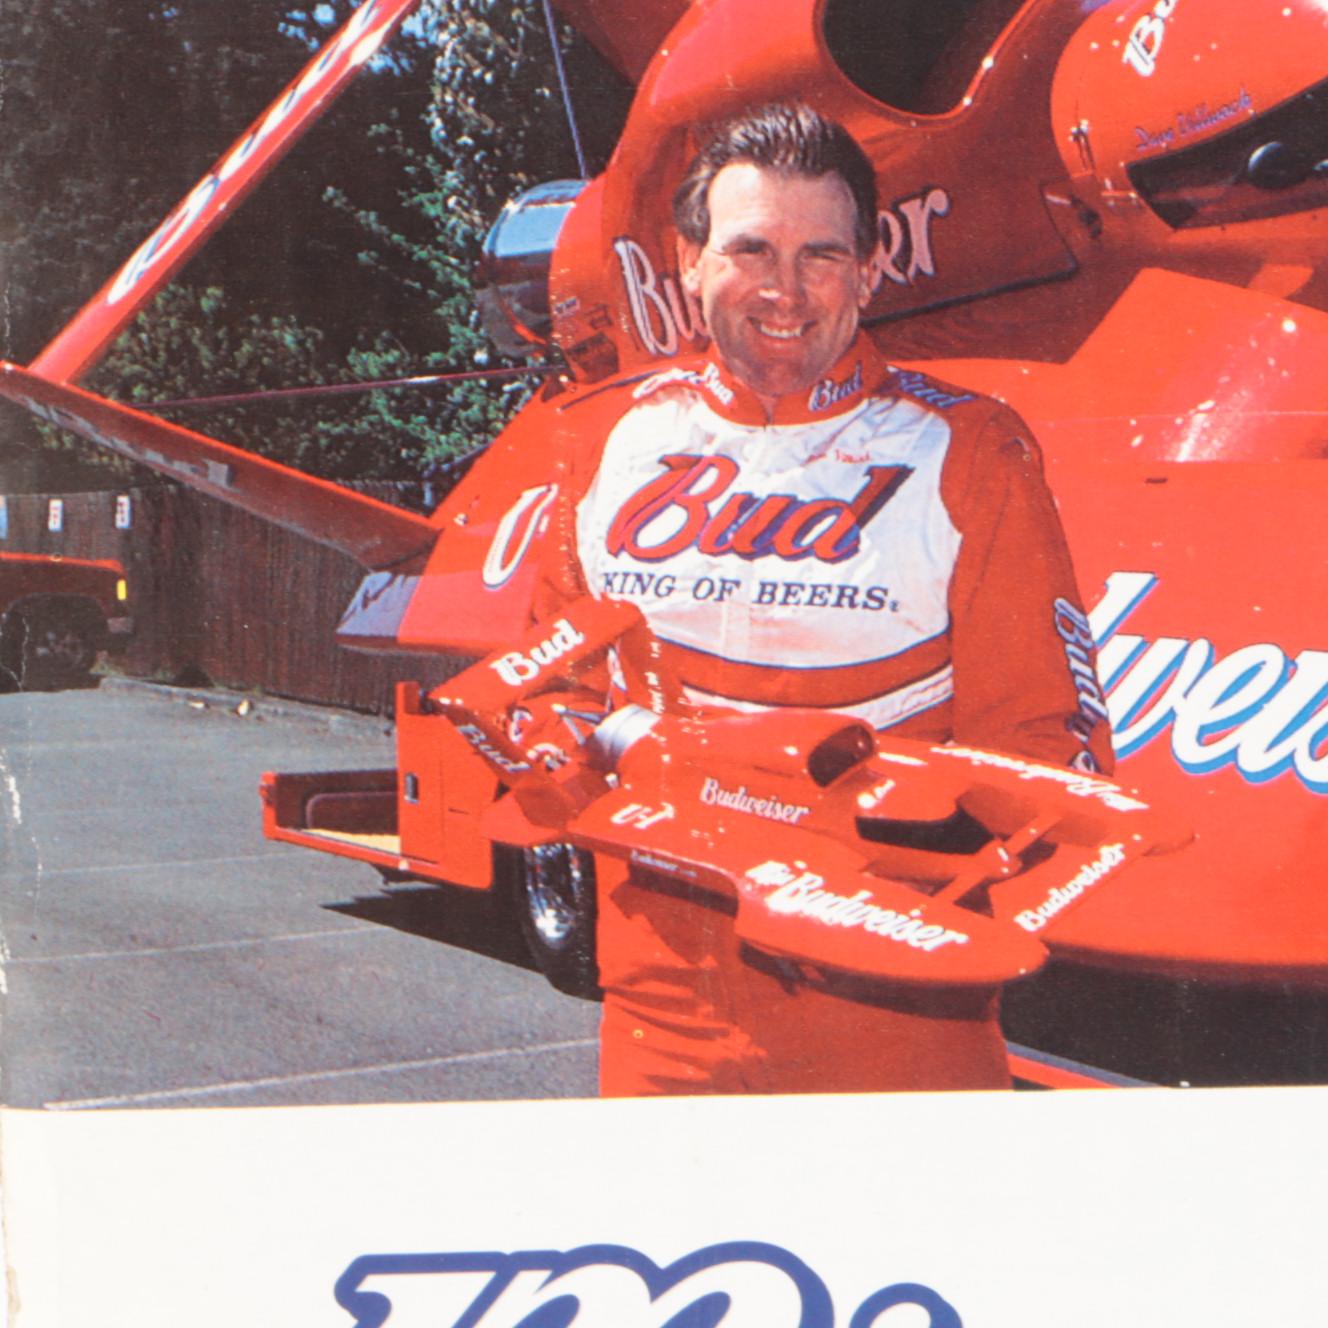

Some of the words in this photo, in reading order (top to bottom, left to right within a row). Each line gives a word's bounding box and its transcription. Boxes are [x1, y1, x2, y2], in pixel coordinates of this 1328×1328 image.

[604, 452, 914, 565] Bud
[691, 576, 742, 603] OF
[490, 618, 586, 687] Bud
[699, 776, 810, 825] Budweiser
[1012, 842, 1126, 933] Budweiser
